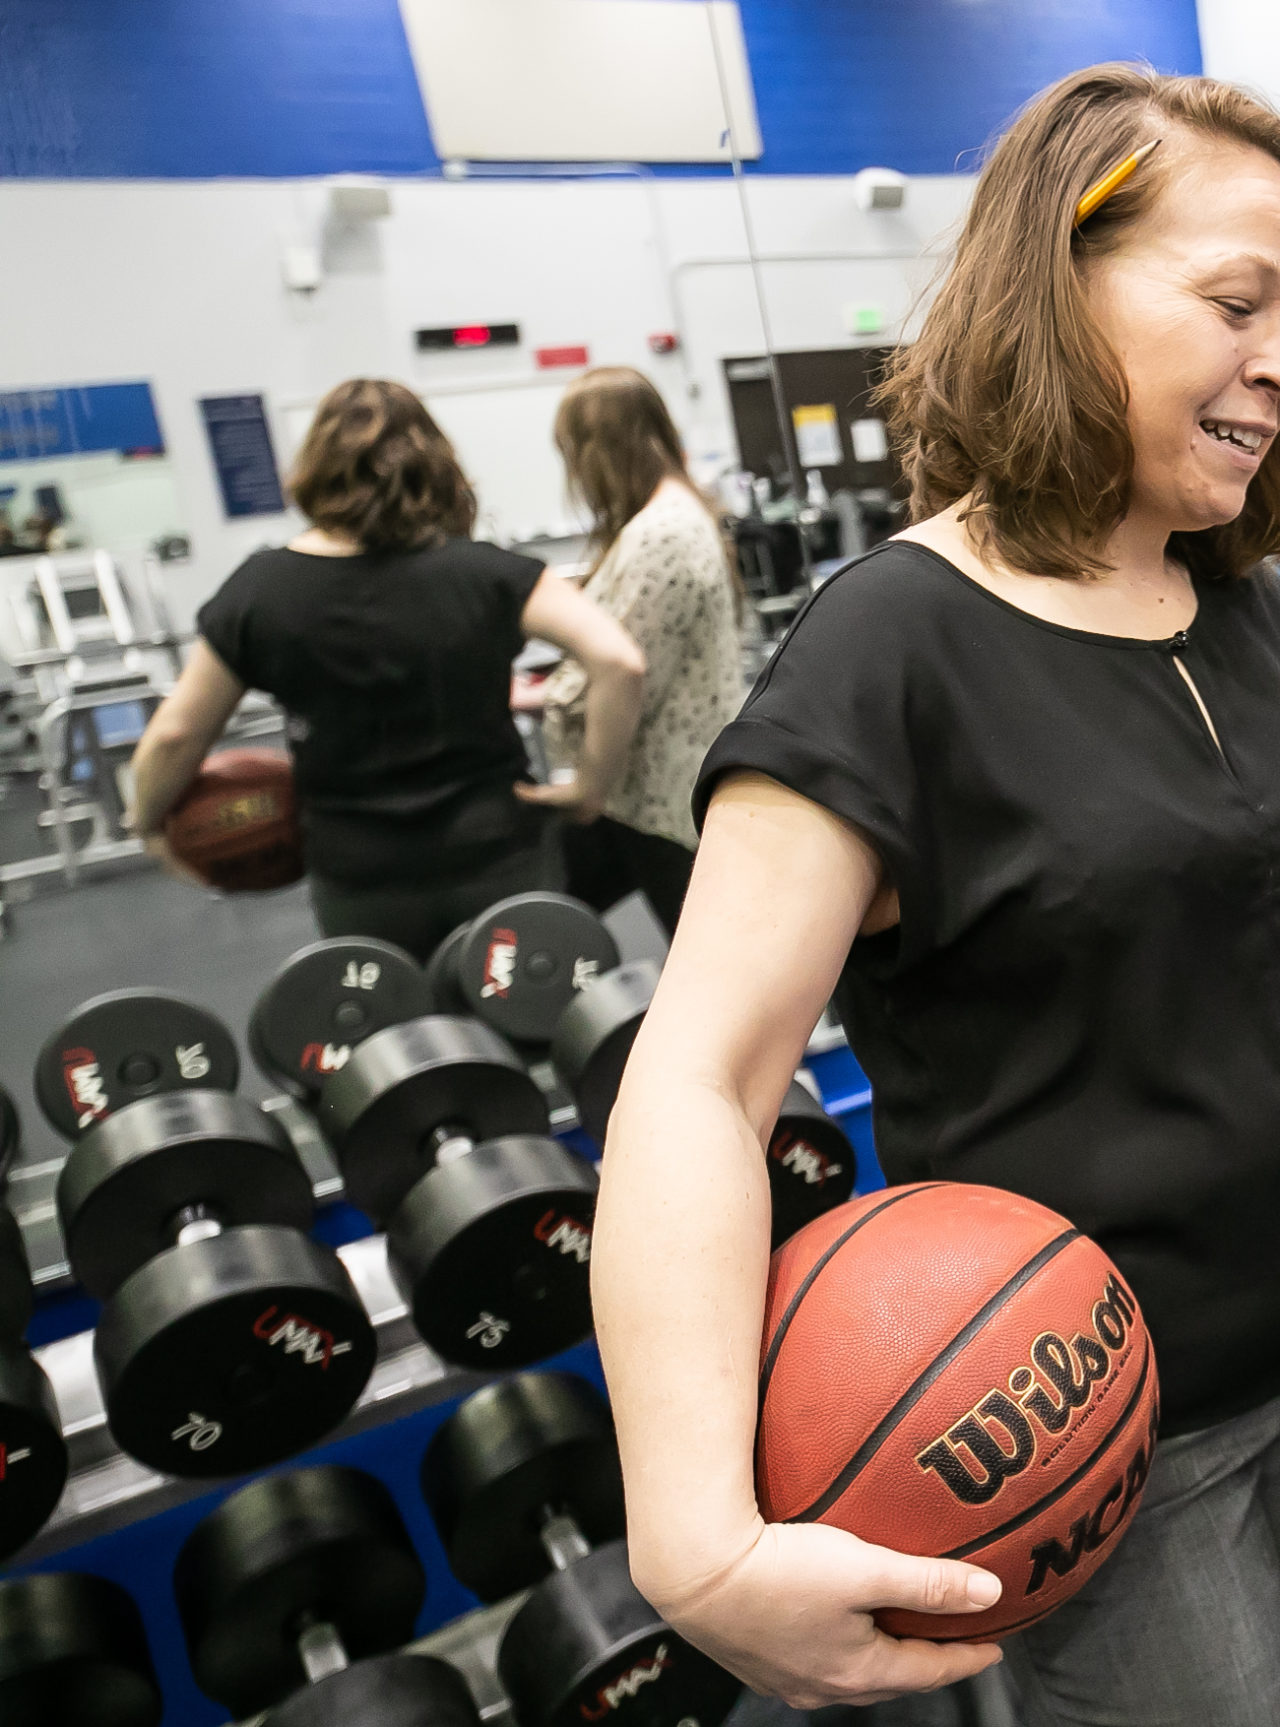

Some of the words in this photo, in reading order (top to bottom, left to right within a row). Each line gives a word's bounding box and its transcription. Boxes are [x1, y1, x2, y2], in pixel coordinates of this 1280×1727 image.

[172, 1411, 222, 1452] 70
[914, 1270, 1140, 1506] Wilson
[1040, 1404, 1097, 1469] SOLUTION
[1097, 1369, 1122, 1403] GAME
